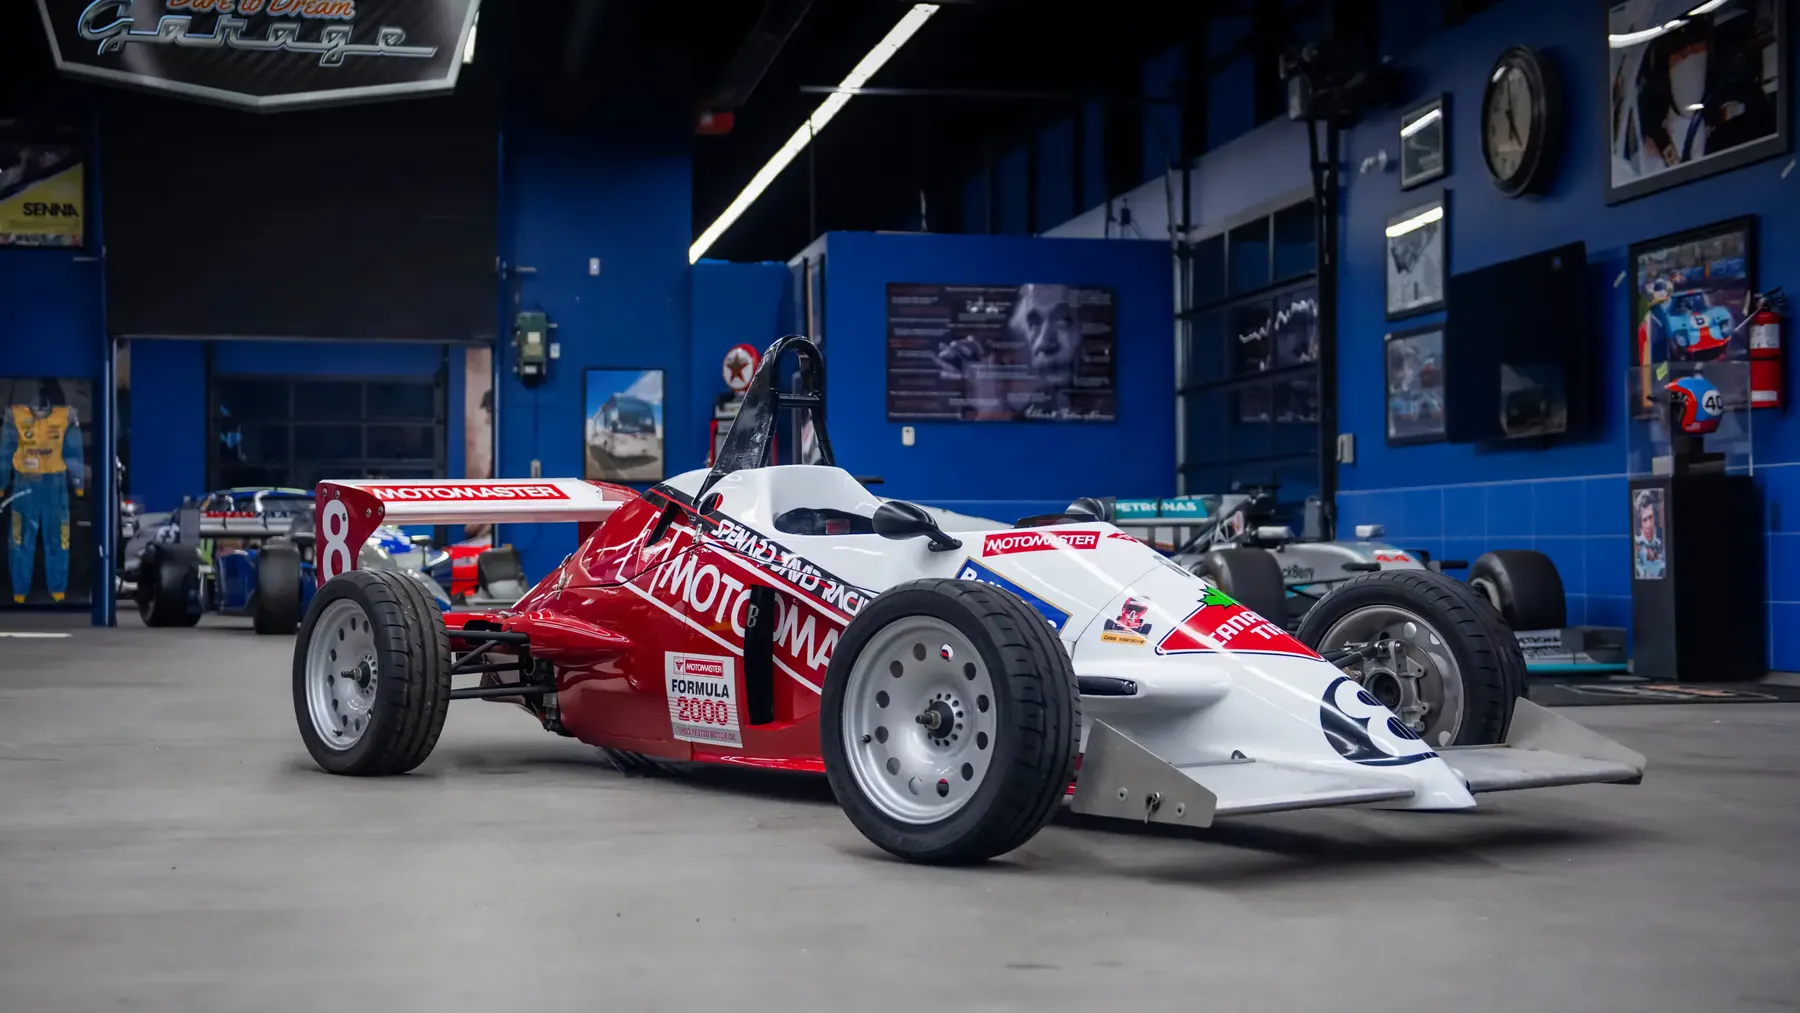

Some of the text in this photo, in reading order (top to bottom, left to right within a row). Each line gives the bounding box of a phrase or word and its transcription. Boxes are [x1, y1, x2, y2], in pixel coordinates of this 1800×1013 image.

[268, 0, 354, 17] Dream
[77, 0, 438, 67] Garage
[23, 202, 80, 218] SENNA
[1704, 395, 1724, 411] 40
[373, 486, 559, 499] MOTOMASTER
[1113, 502, 1198, 512] PETRONAS
[322, 499, 351, 582] 8
[986, 534, 1097, 552] MOTOMASTER
[821, 580, 871, 617] RACI
[686, 662, 723, 674] MOTOMASTER
[671, 679, 730, 699] FORMULA
[677, 696, 728, 726] 2000
